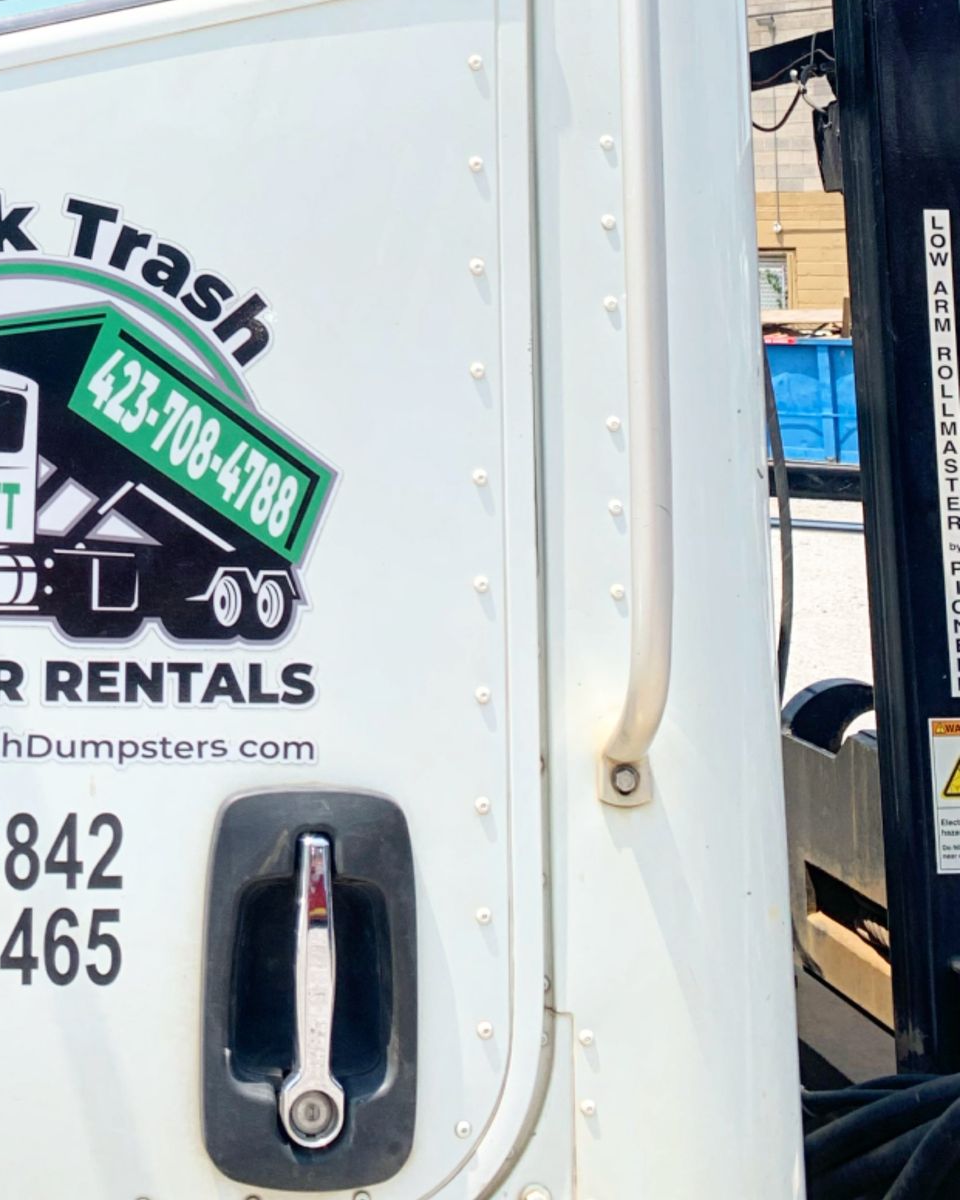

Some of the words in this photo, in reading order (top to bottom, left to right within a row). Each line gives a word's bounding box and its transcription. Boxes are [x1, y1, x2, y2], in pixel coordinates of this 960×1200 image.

[929, 216, 948, 267] LOW
[67, 198, 269, 367] Trash
[934, 281, 951, 332] ARM
[87, 349, 297, 537] 423-708-4788
[45, 661, 315, 705] RENTALS
[239, 739, 315, 760] com
